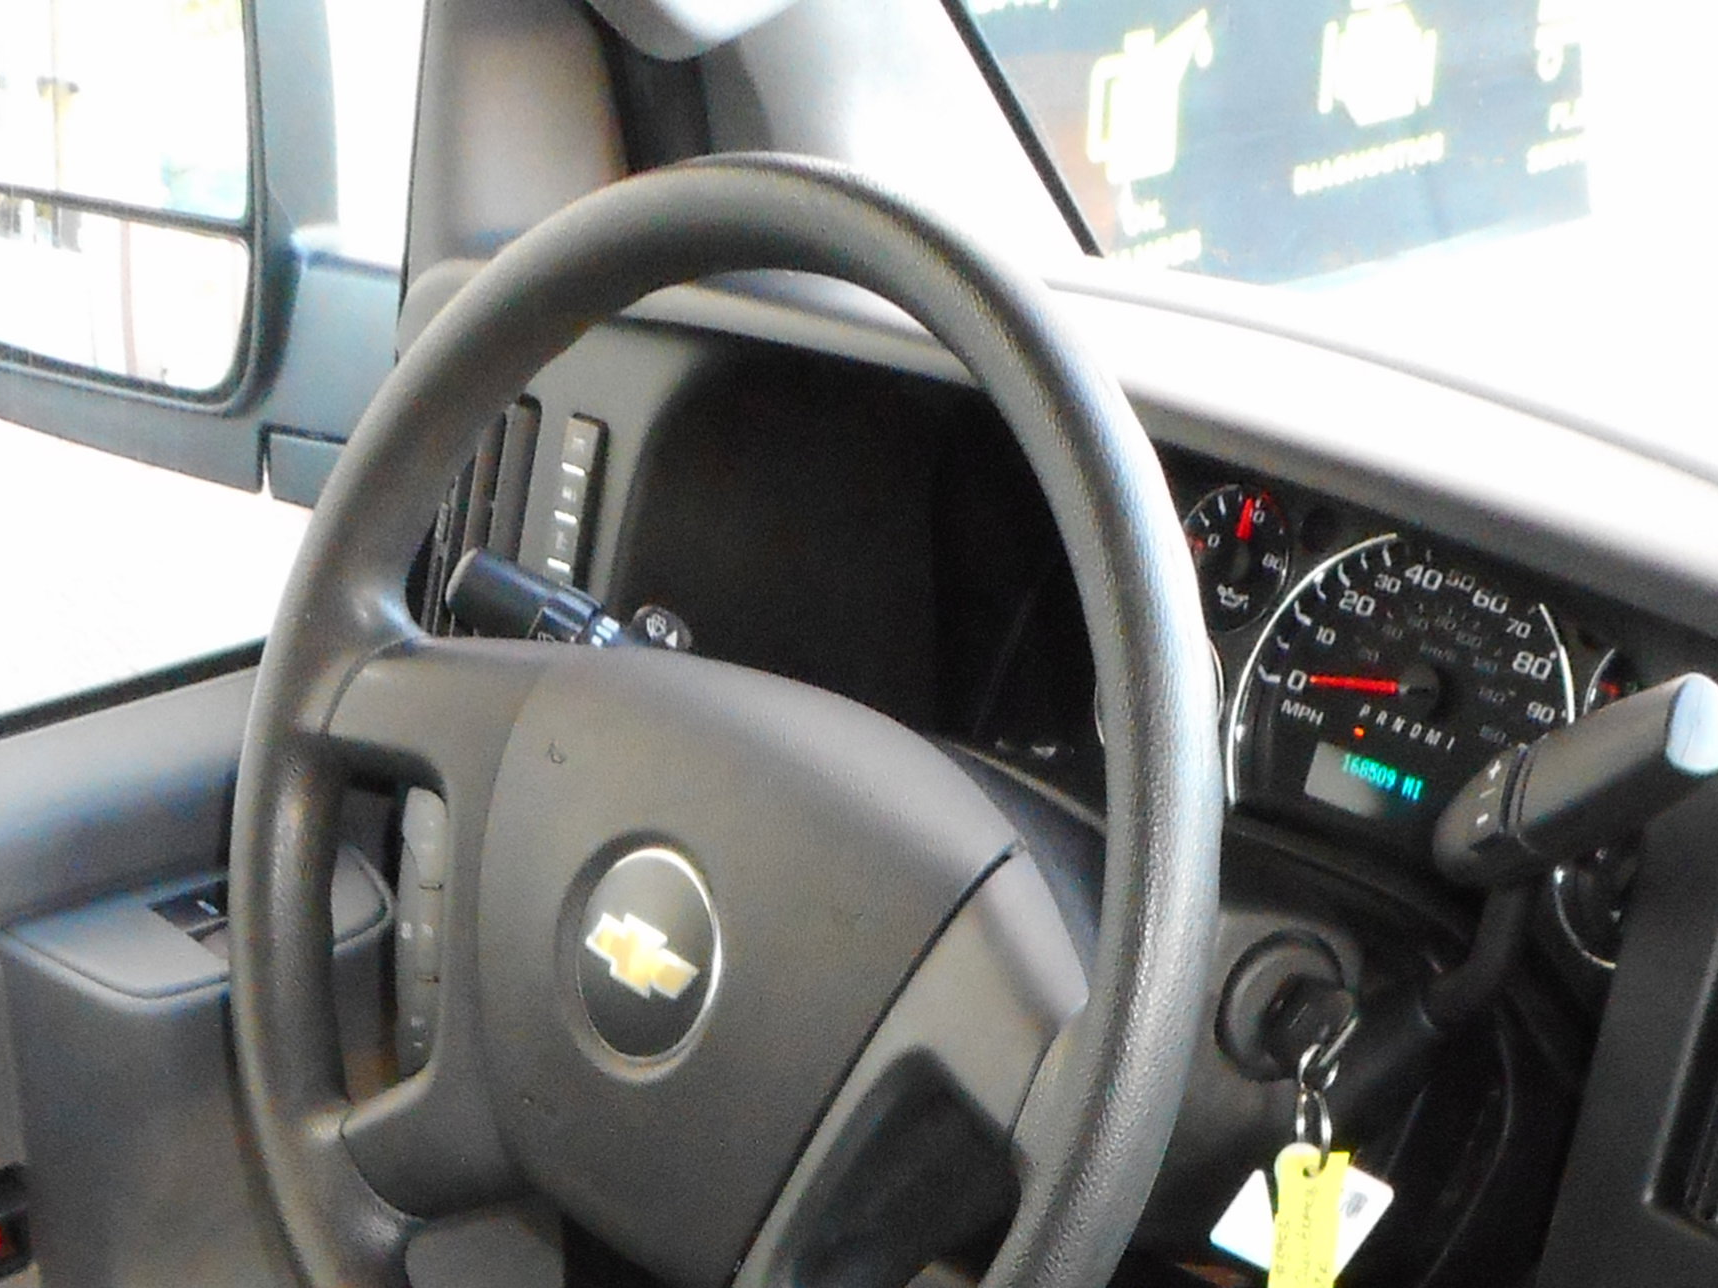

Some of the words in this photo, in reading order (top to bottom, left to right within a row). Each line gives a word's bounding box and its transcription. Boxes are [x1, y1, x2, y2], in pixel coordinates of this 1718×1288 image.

[1375, 573, 1402, 594] 30
[1404, 563, 1443, 592] 40
[1444, 568, 1476, 593] 50
[1339, 589, 1375, 617] 20
[1472, 588, 1509, 614] 60
[1315, 625, 1336, 645] 10
[1505, 618, 1532, 640] 70
[1512, 651, 1552, 681] 80
[1287, 669, 1308, 692] 0
[1281, 699, 1325, 726] MPH
[1526, 701, 1556, 724] 90
[1341, 752, 1398, 790] 168509
